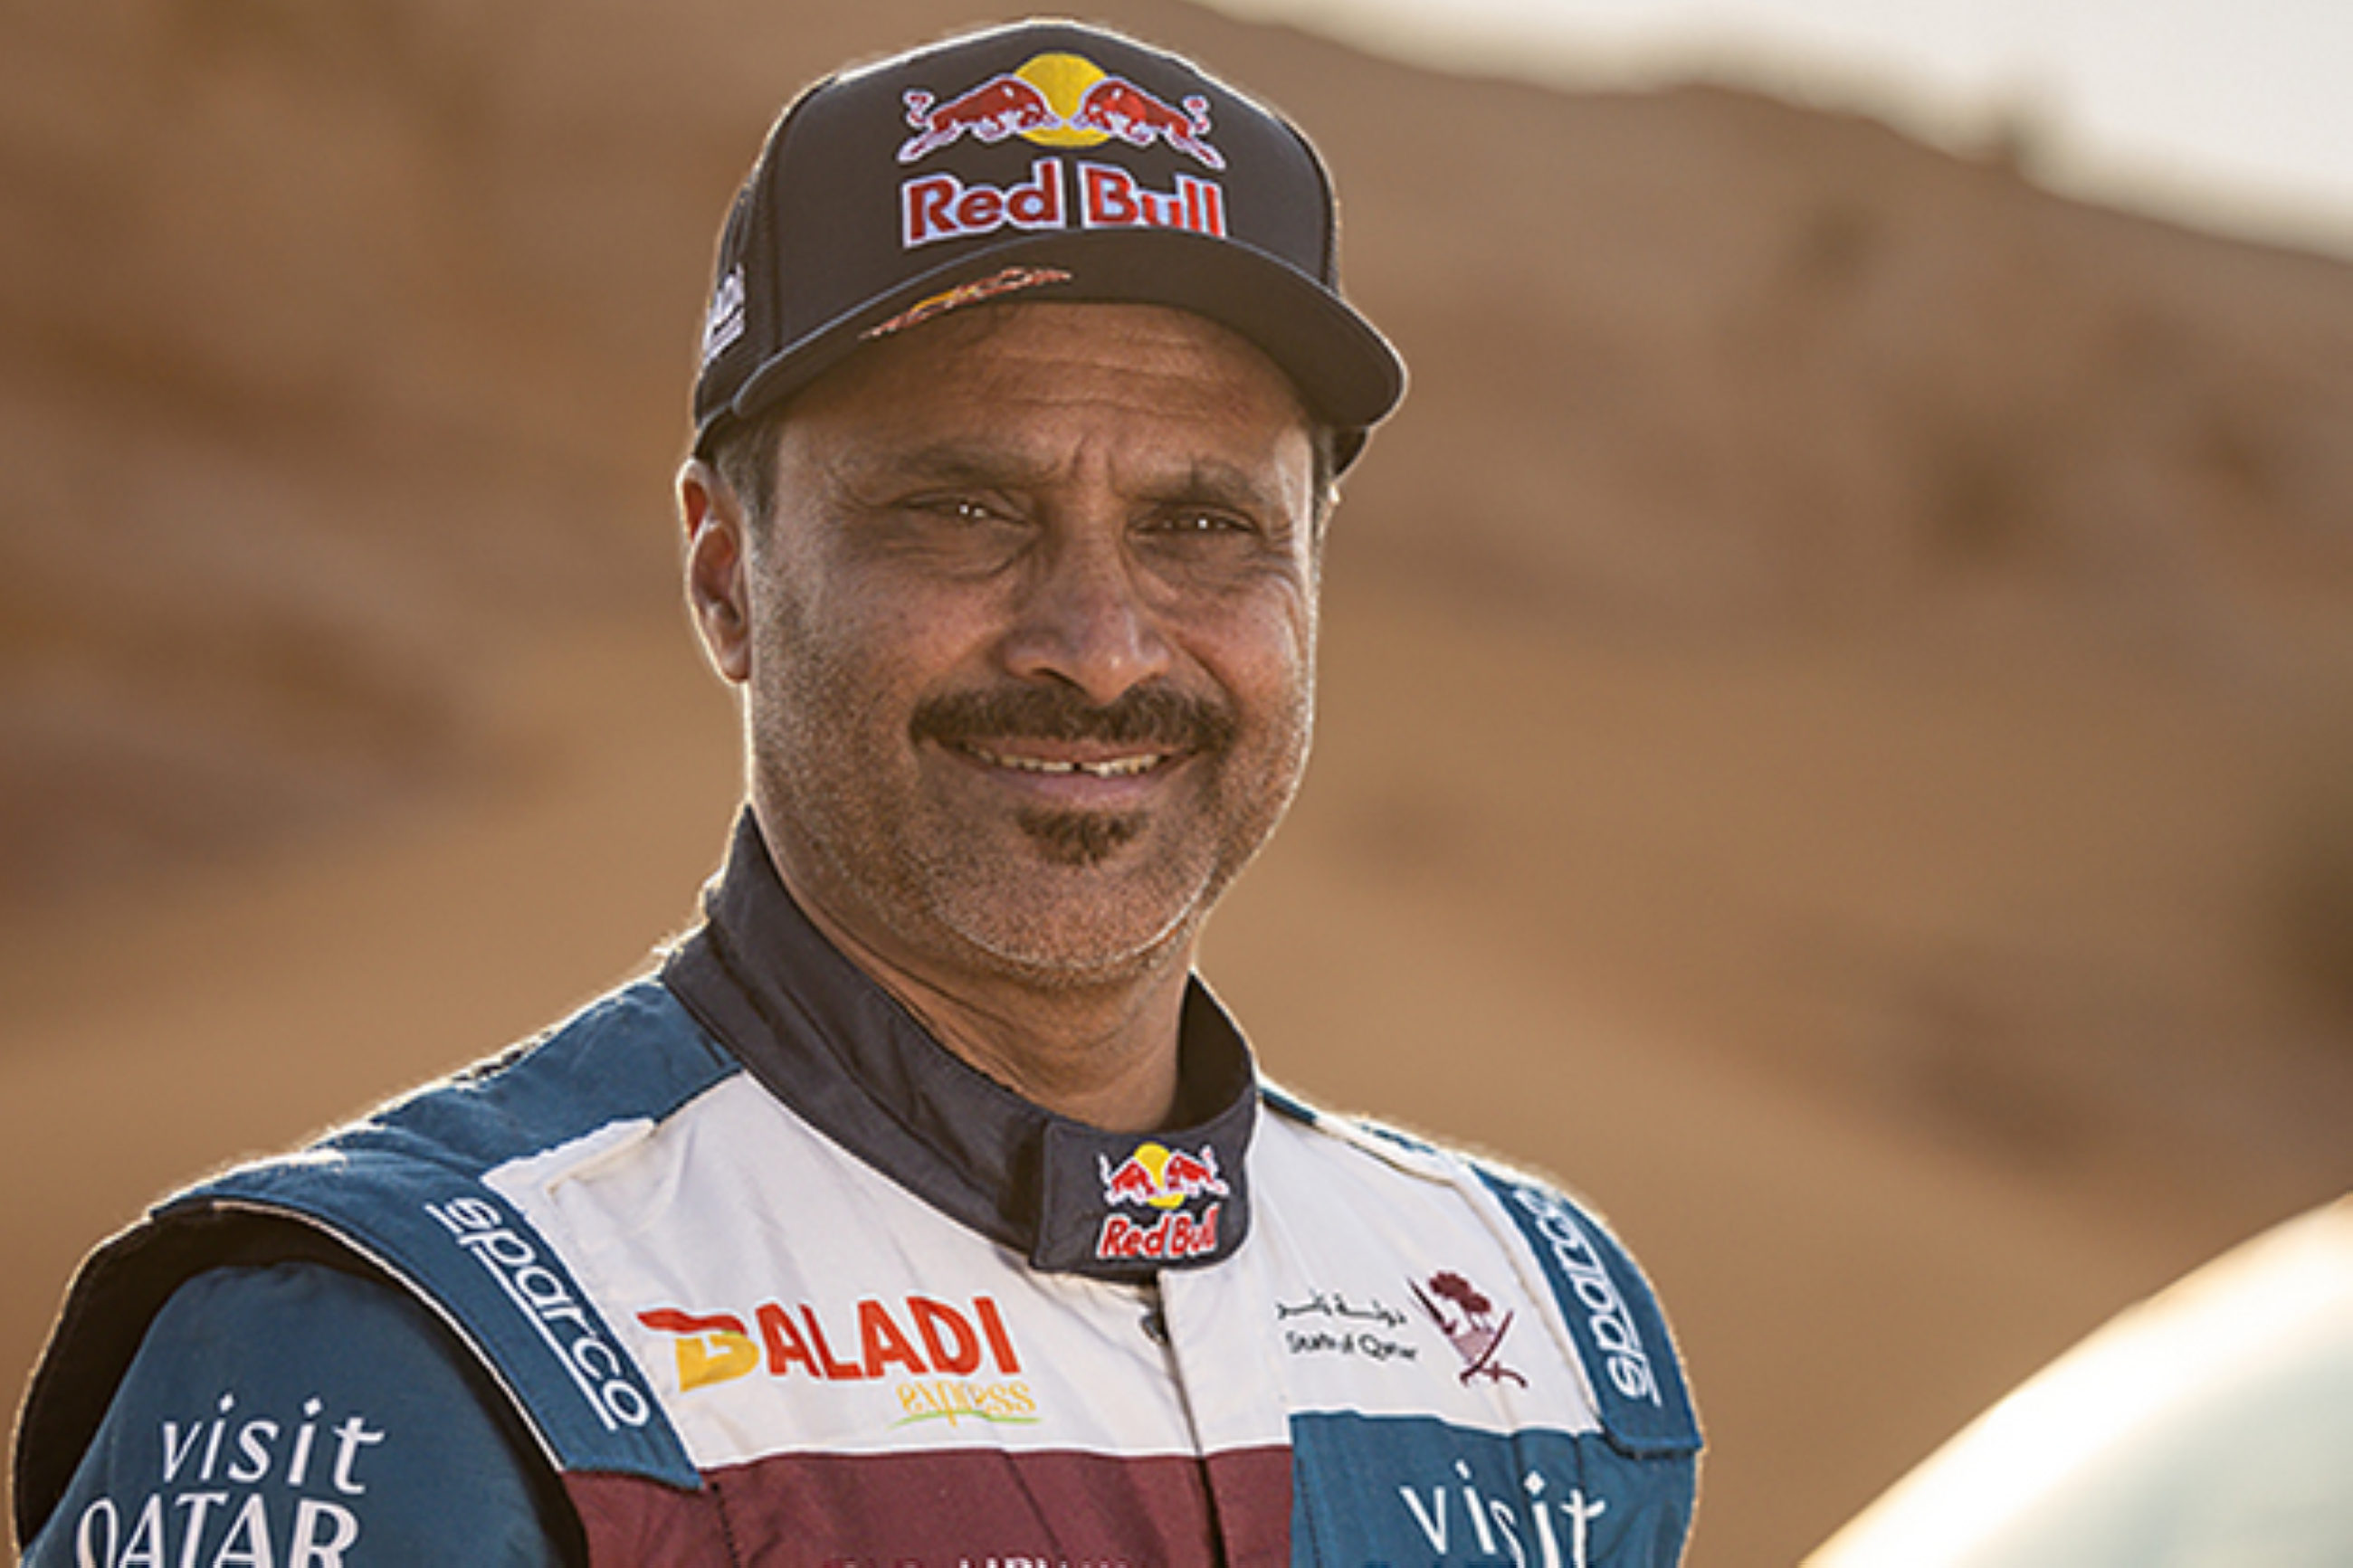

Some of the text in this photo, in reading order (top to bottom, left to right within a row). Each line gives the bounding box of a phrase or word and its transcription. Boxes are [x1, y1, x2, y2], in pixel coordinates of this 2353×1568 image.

[905, 157, 1225, 246] Red Bull
[1096, 1212, 1171, 1259] Red
[444, 1197, 651, 1426] sparco
[636, 1296, 1022, 1392] BALADI
[163, 1393, 385, 1494] visit
[76, 1493, 359, 1568] QATAR
[1399, 1459, 1606, 1568] visit
